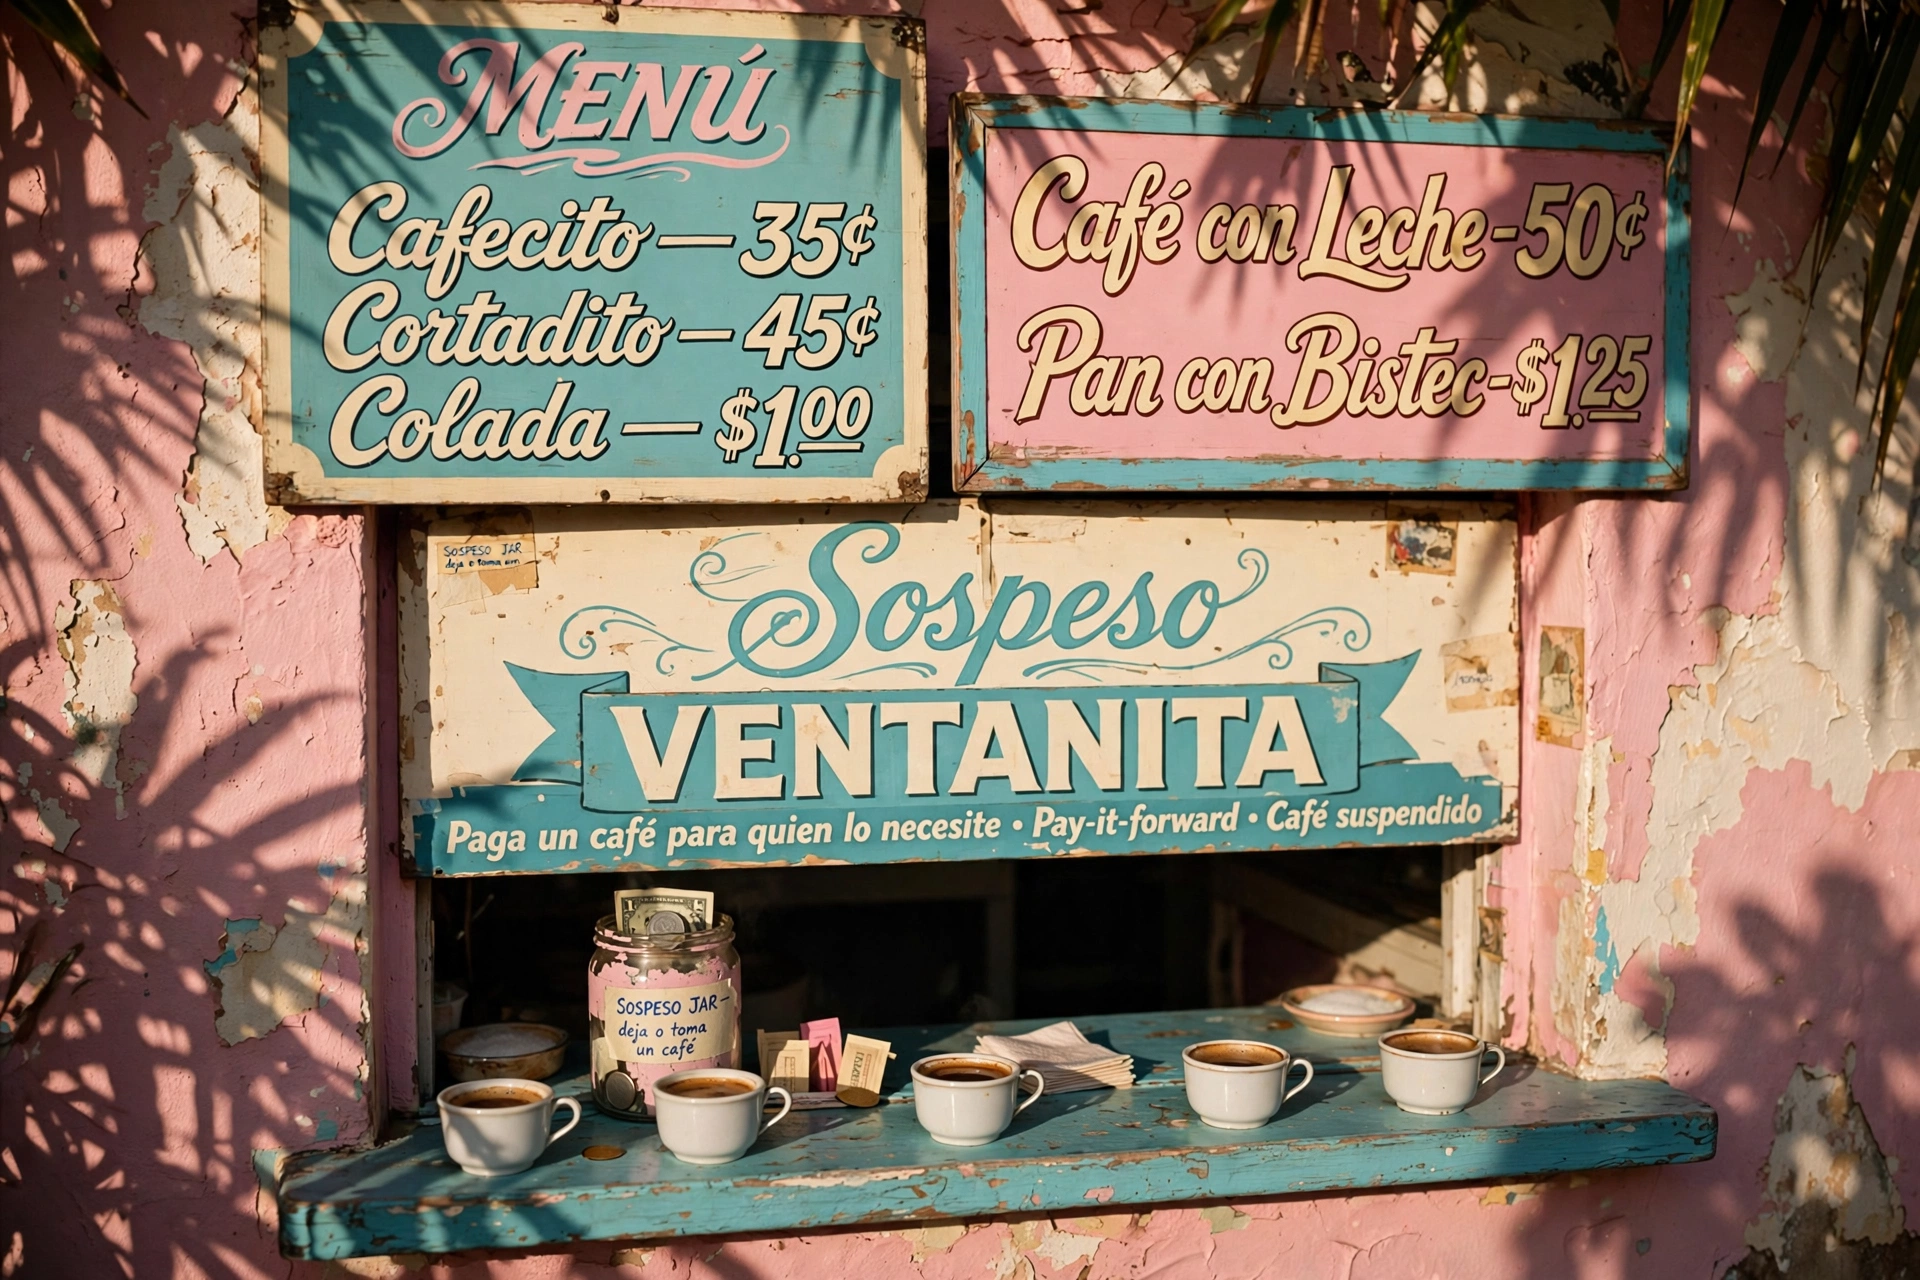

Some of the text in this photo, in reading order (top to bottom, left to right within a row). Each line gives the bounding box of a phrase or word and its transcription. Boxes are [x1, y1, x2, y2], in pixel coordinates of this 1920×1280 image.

[392, 38, 775, 158] MENÚ
[328, 181, 653, 300] Cafecito
[739, 201, 878, 279] 35¢
[1011, 154, 1191, 296] Café
[1198, 202, 1297, 265] con
[323, 280, 675, 373] Cortadito
[741, 292, 881, 371] 45¢
[1016, 304, 1163, 427] Pan
[1174, 356, 1273, 414] con
[329, 373, 609, 467] Colada
[714, 385, 873, 469] $1.00
[443, 542, 523, 557] SOSPESO JAR
[692, 520, 1268, 686] Sospeso
[609, 695, 1327, 803] VENTANITA
[446, 794, 1483, 861] Paga un café para quien lo necesite Pay-it-forward Café suspendido
[616, 997, 682, 1016] SOSPESO
[618, 1020, 707, 1044] deja o toma
[636, 1037, 697, 1061] un café
